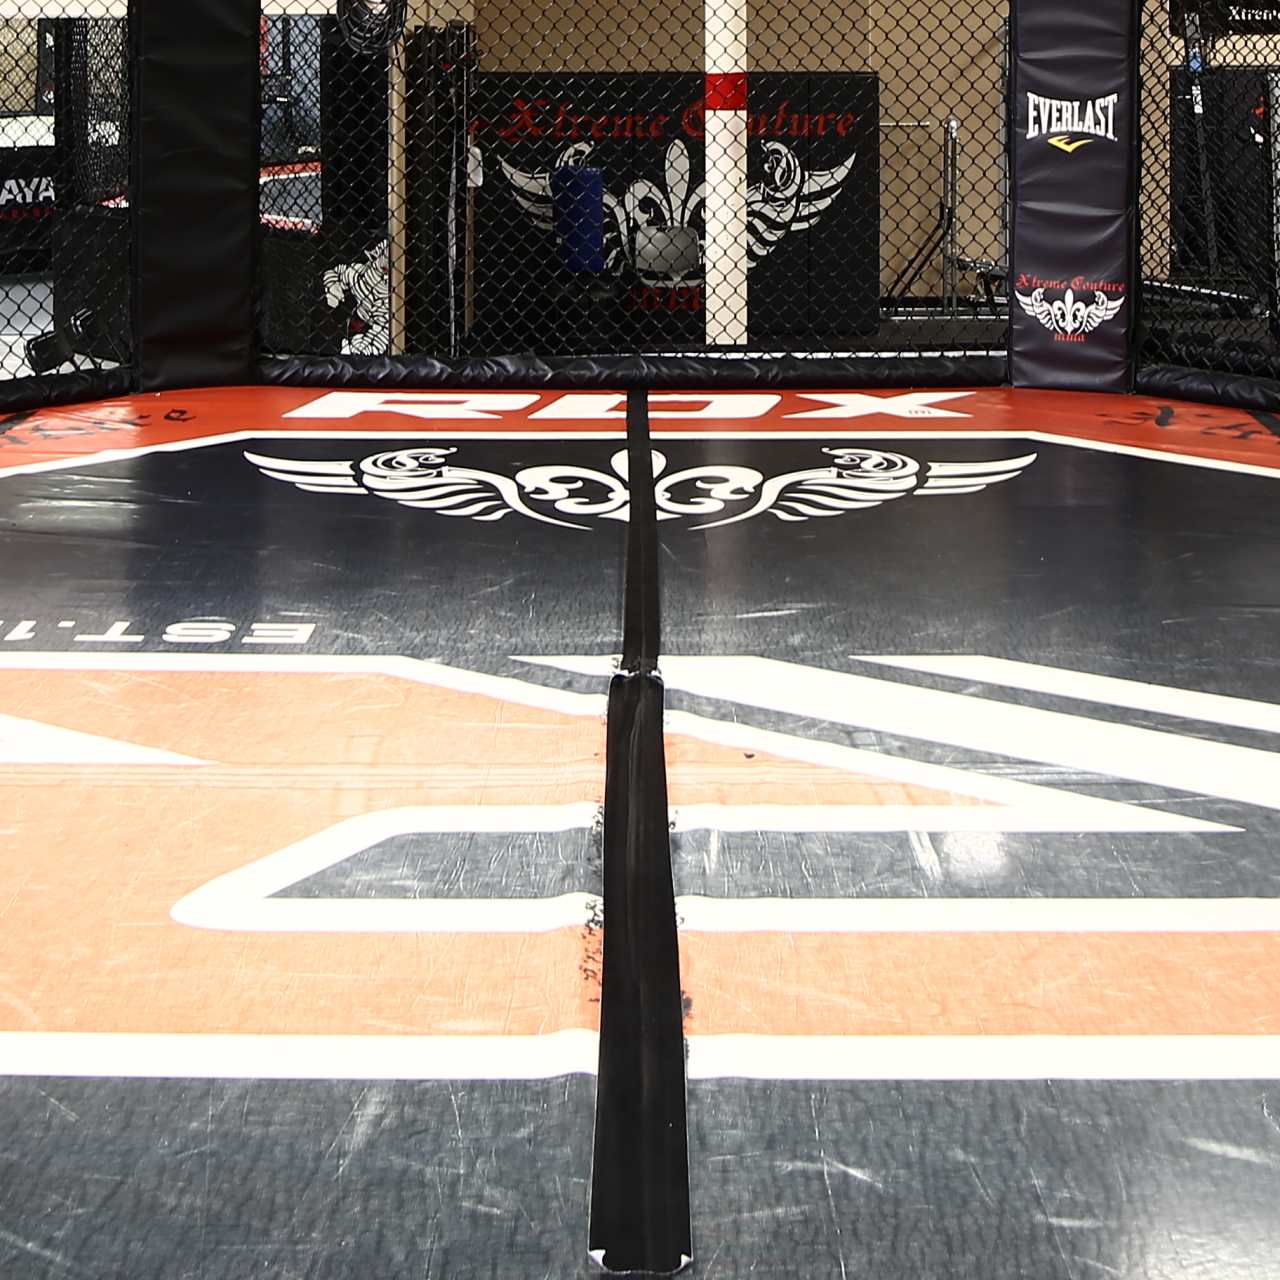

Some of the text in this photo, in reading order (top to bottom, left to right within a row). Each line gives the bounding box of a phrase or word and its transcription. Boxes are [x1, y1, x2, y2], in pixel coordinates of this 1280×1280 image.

[681, 98, 857, 138] Cuture
[1025, 91, 1119, 142] EVERLAST
[1016, 272, 1125, 292] Xtreme Couture
[282, 391, 977, 419] RDX
